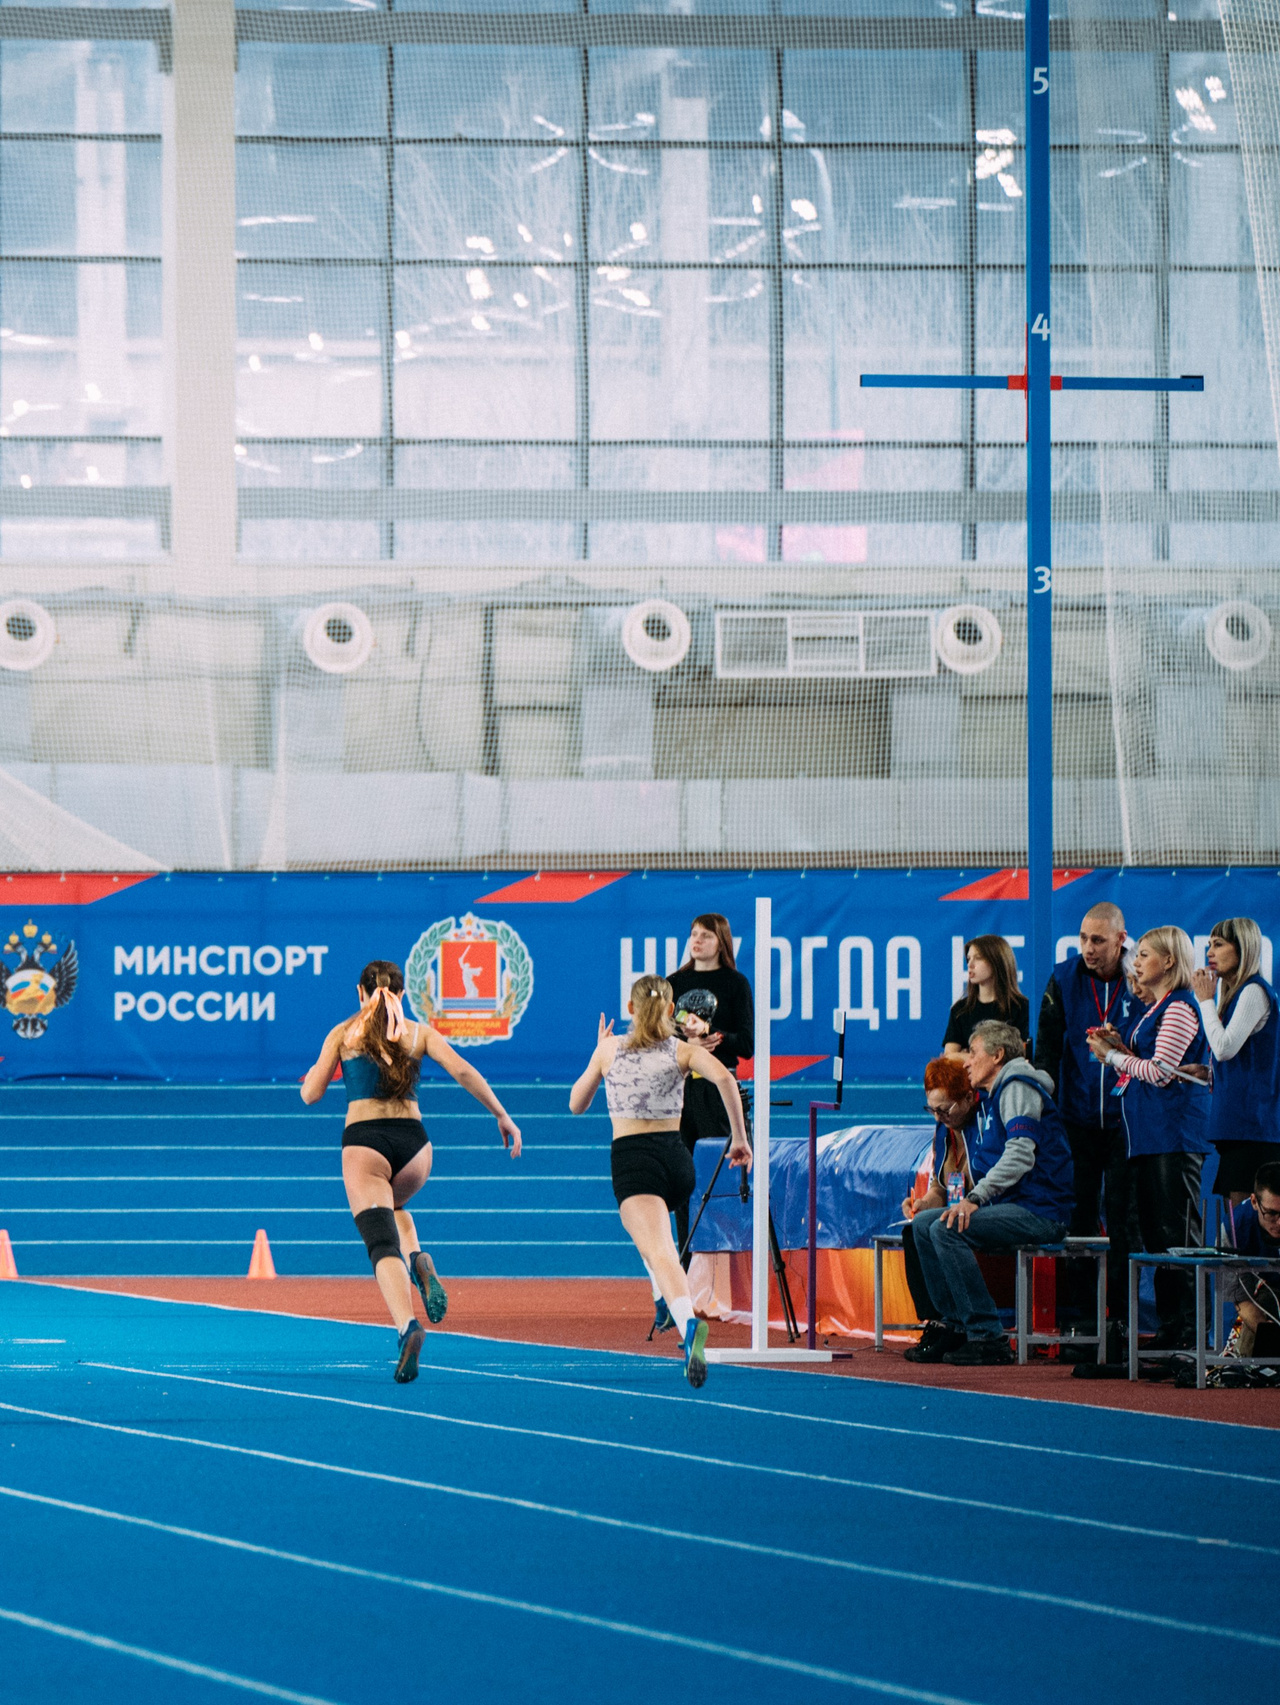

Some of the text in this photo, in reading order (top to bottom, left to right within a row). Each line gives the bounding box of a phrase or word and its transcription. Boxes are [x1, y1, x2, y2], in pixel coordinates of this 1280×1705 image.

[1033, 66, 1049, 95] 5
[1031, 312, 1051, 342] 4
[1033, 565, 1052, 594] 3
[114, 945, 329, 976] МИНСПОРТ
[620, 936, 922, 1031] НОГДА
[114, 991, 276, 1022] РОССИИ
